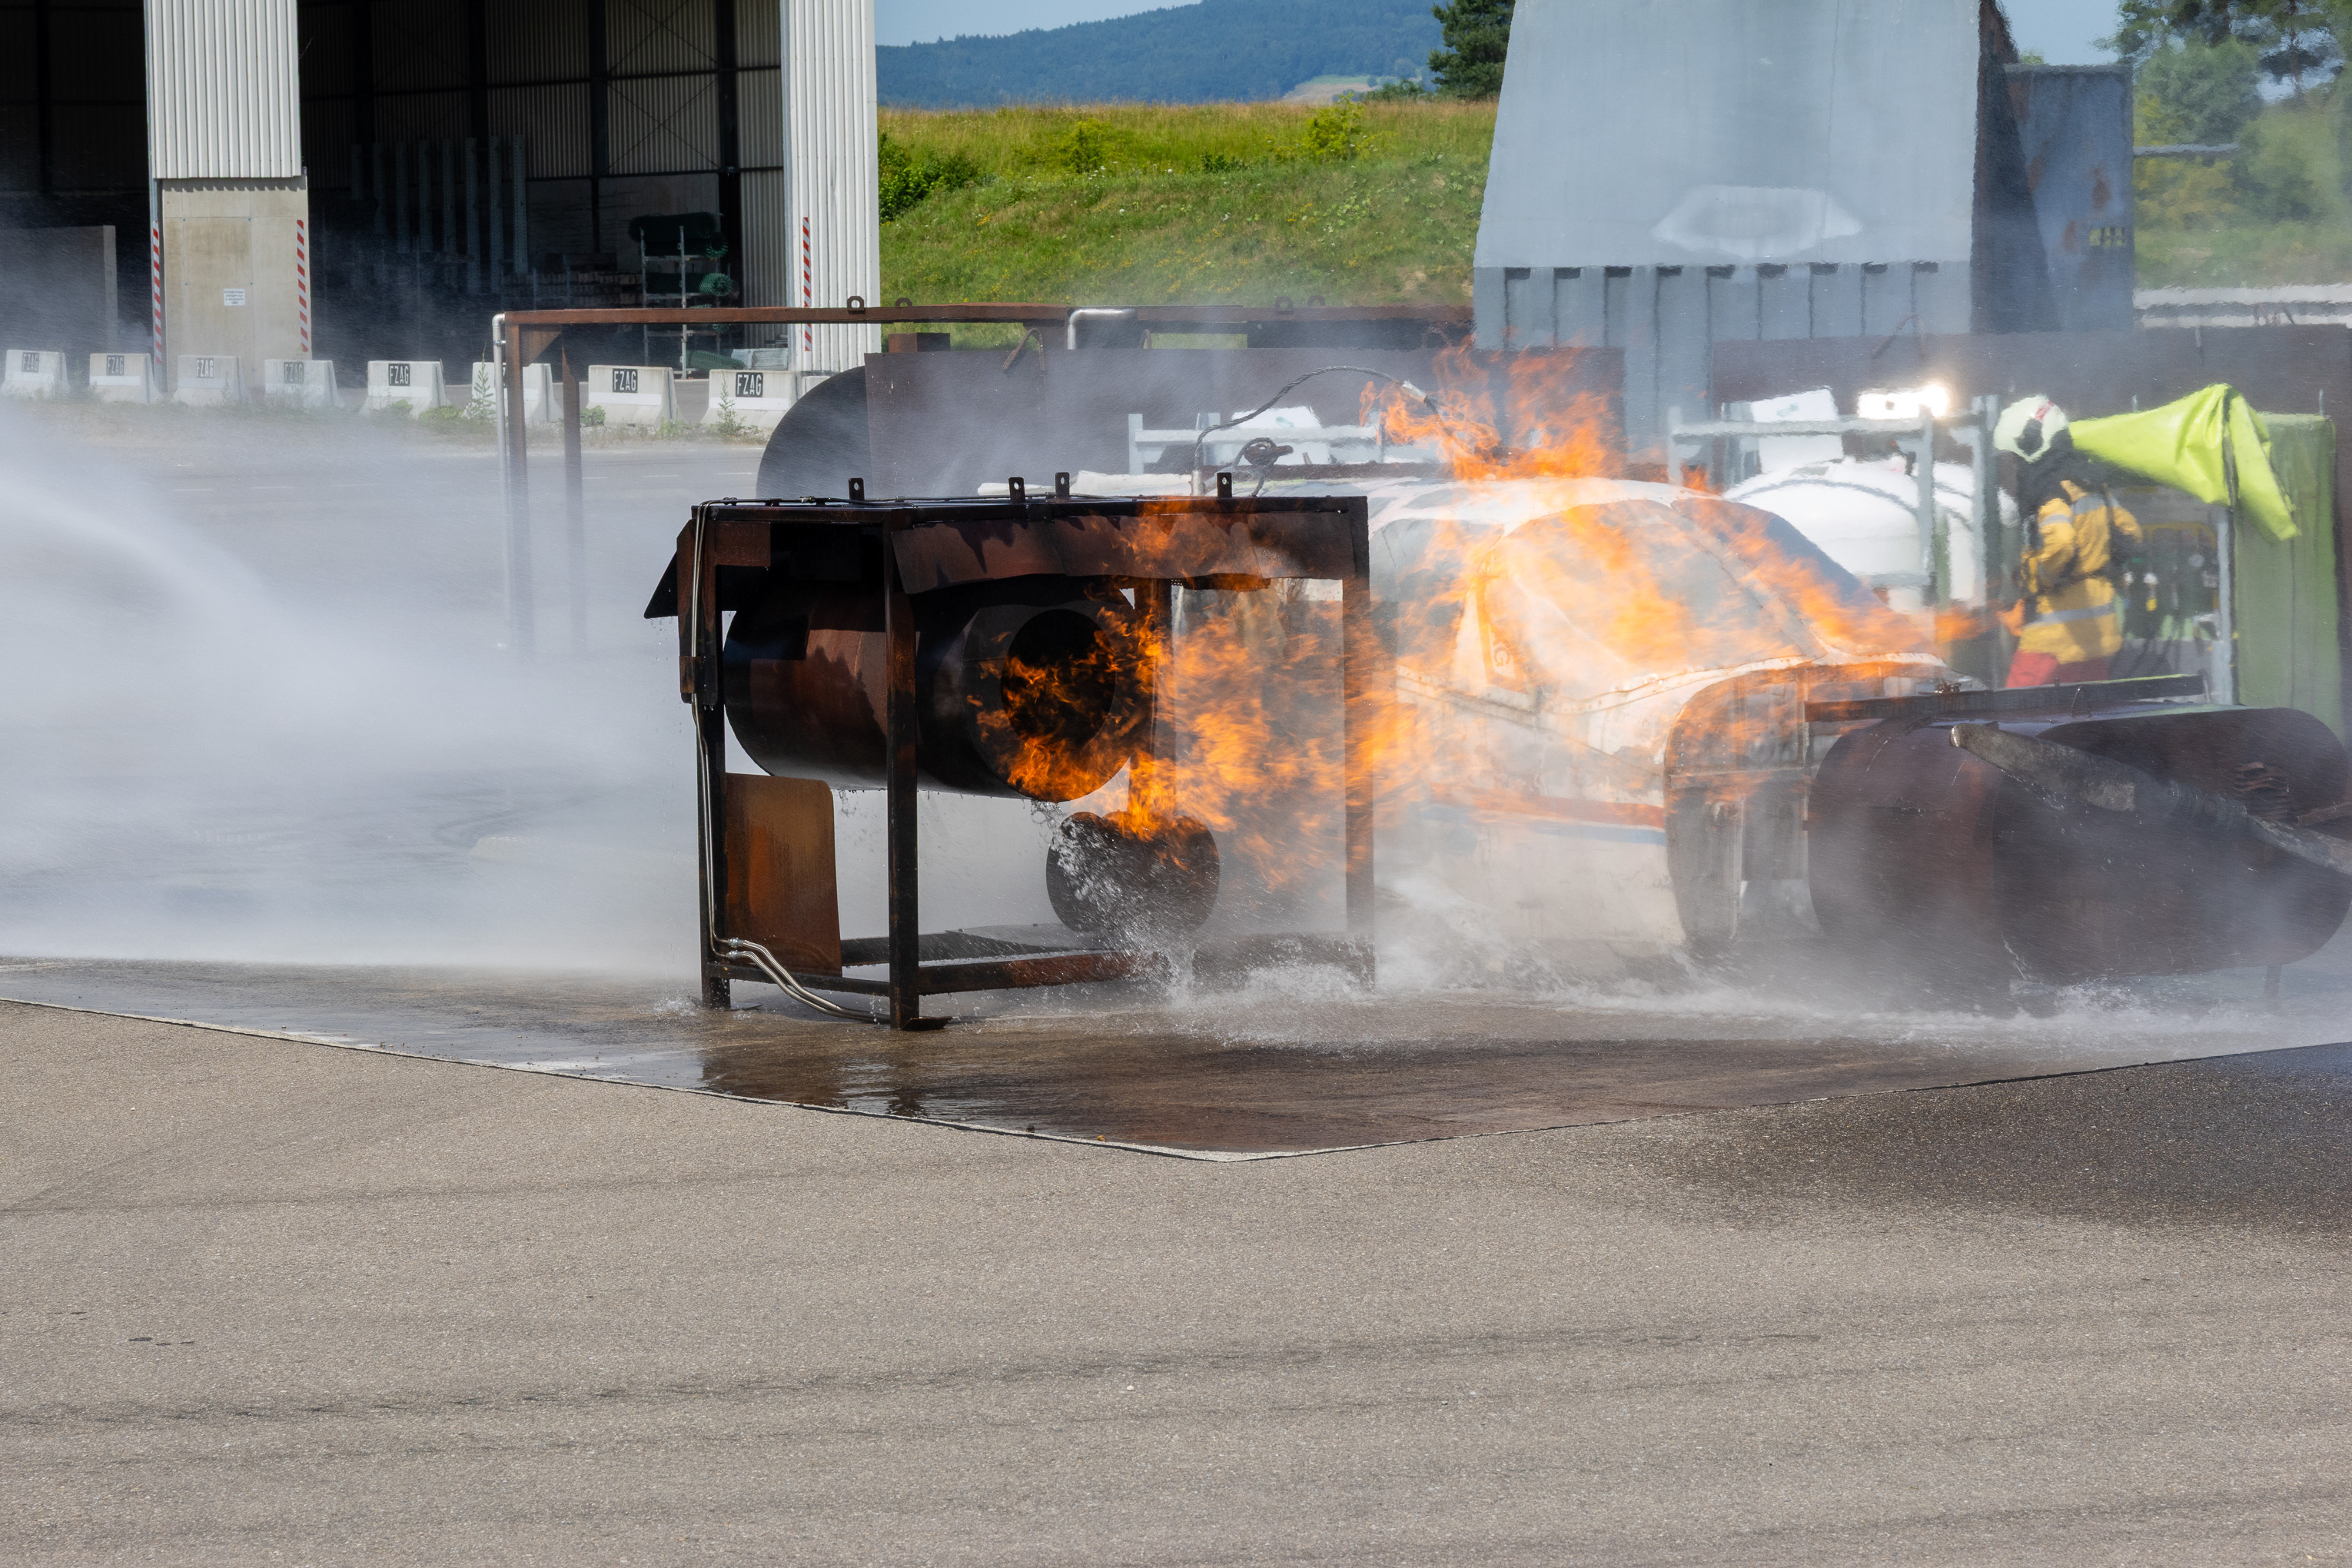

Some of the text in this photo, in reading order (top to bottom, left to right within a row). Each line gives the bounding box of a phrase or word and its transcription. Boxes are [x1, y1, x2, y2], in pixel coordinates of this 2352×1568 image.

[22, 353, 38, 371] FZAG
[107, 356, 124, 375] FZAG
[196, 359, 214, 377] FZAG
[284, 364, 304, 382] FZAG
[389, 366, 409, 384] FZAG
[613, 370, 636, 391] FZAG
[737, 374, 762, 395] FZAG
